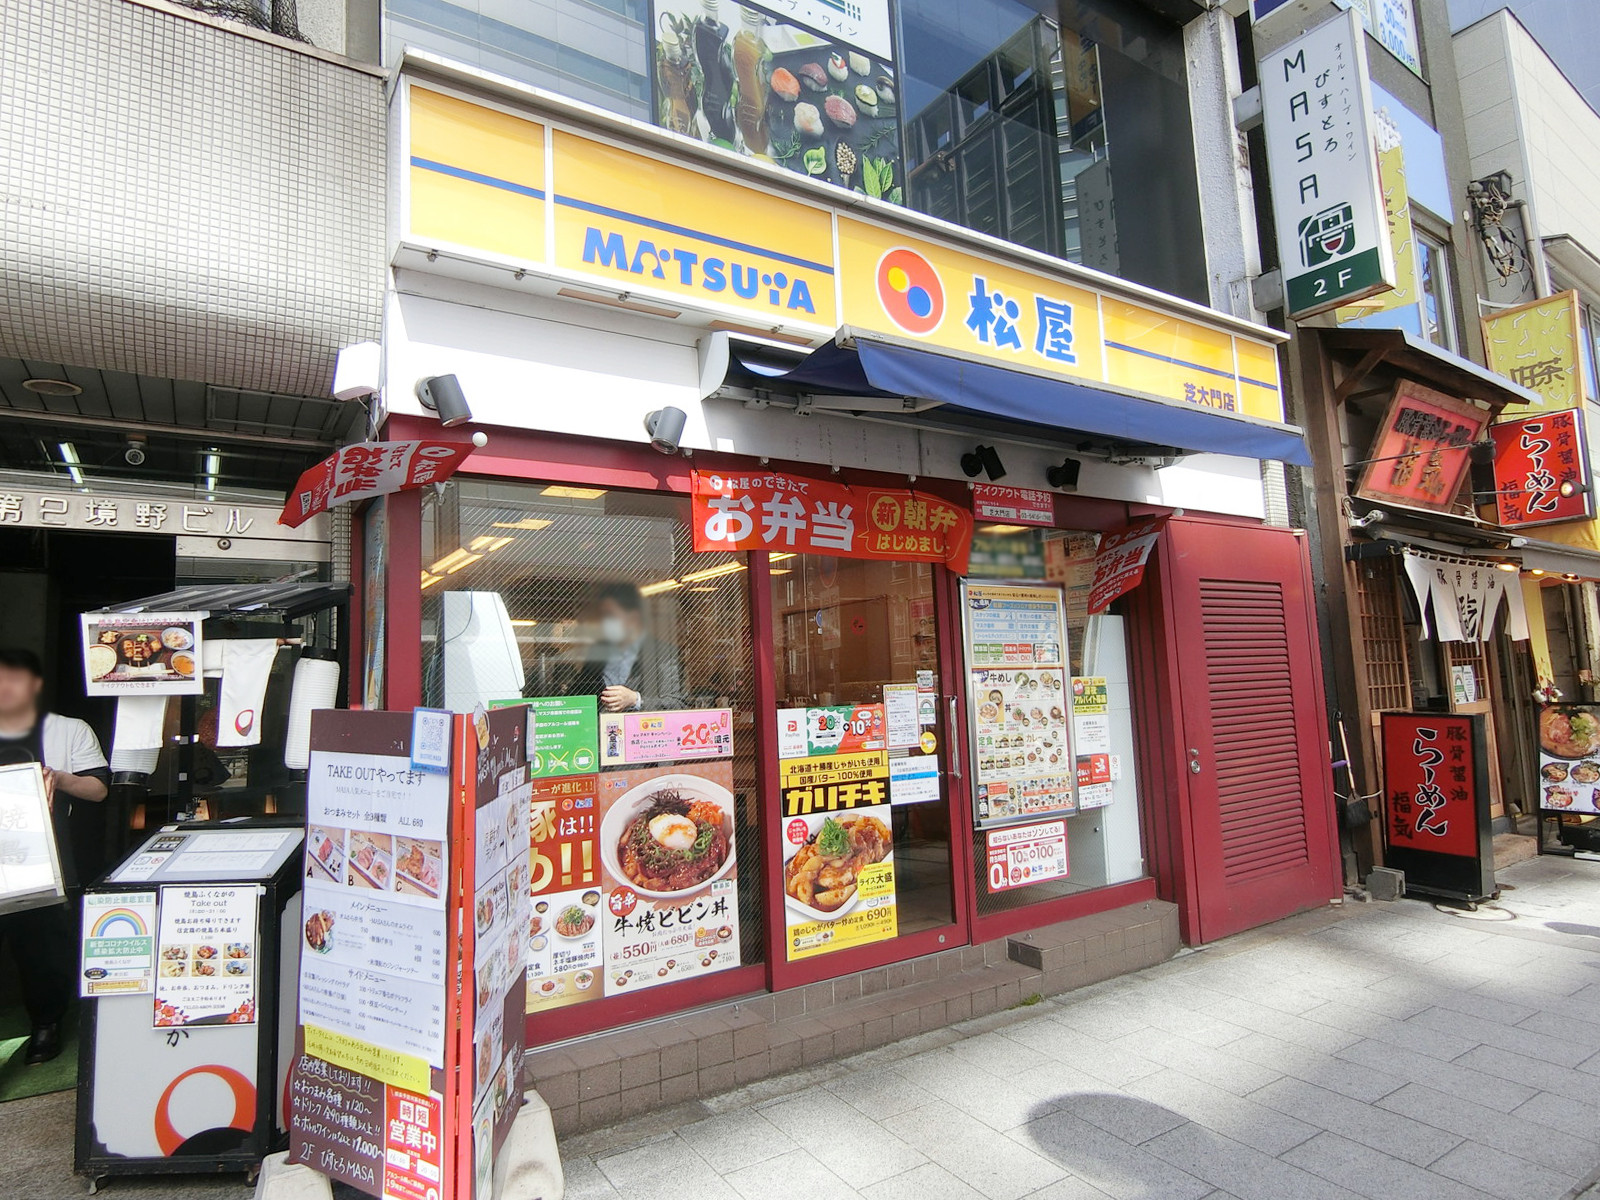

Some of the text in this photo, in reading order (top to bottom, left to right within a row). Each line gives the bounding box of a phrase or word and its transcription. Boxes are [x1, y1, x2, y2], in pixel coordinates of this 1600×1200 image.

[1315, 69, 1338, 152] びすとろ
[1334, 43, 1356, 161] オイル・ハーブ・ワイン
[1283, 49, 1318, 205] MASA
[582, 226, 816, 315] MATSUYA
[1313, 268, 1352, 297] 2F
[966, 274, 1077, 364] 松屋
[1183, 382, 1235, 412] 芝大門店
[333, 446, 390, 499] お弁当
[1520, 423, 1559, 514] らーめん
[727, 475, 809, 495] 松屋のできたて
[975, 484, 1051, 503] テイクアウト電話予約
[704, 492, 855, 551] お弁当
[876, 501, 896, 527] 新
[903, 498, 959, 534] 朝弁
[876, 533, 951, 553] はじめまし
[1092, 545, 1146, 587] お弁当
[989, 672, 1012, 683] 牛めし
[1005, 704, 1011, 713] 丼
[978, 735, 993, 746] 定食
[1026, 733, 1043, 743] カレー
[328, 765, 353, 779] TAKE
[790, 757, 880, 774] 北海道十勝産じゃがいも使用
[1446, 726, 1468, 802] 豚骨醤油
[800, 773, 835, 785] 国産バター
[1413, 727, 1448, 836] らーめん
[786, 781, 886, 816] ガリチキ
[324, 807, 361, 820] おつまみセット
[306, 866, 314, 879] A
[348, 874, 355, 887] B
[859, 871, 893, 887] ライス大盛
[184, 891, 235, 899] 焼鳥ふくながの
[395, 880, 403, 892] C
[88, 896, 152, 906] 染防止徹底宣言
[191, 900, 212, 908] Take
[614, 896, 729, 937] 牛焼ビビン丼
[867, 907, 892, 920] 690円
[90, 939, 147, 948] 新型コロナウイルス
[93, 947, 144, 956] 感染拡大防止中
[402, 1104, 427, 1124] 時短
[390, 1118, 437, 1154] 営業中
[300, 1142, 315, 1161] 2F
